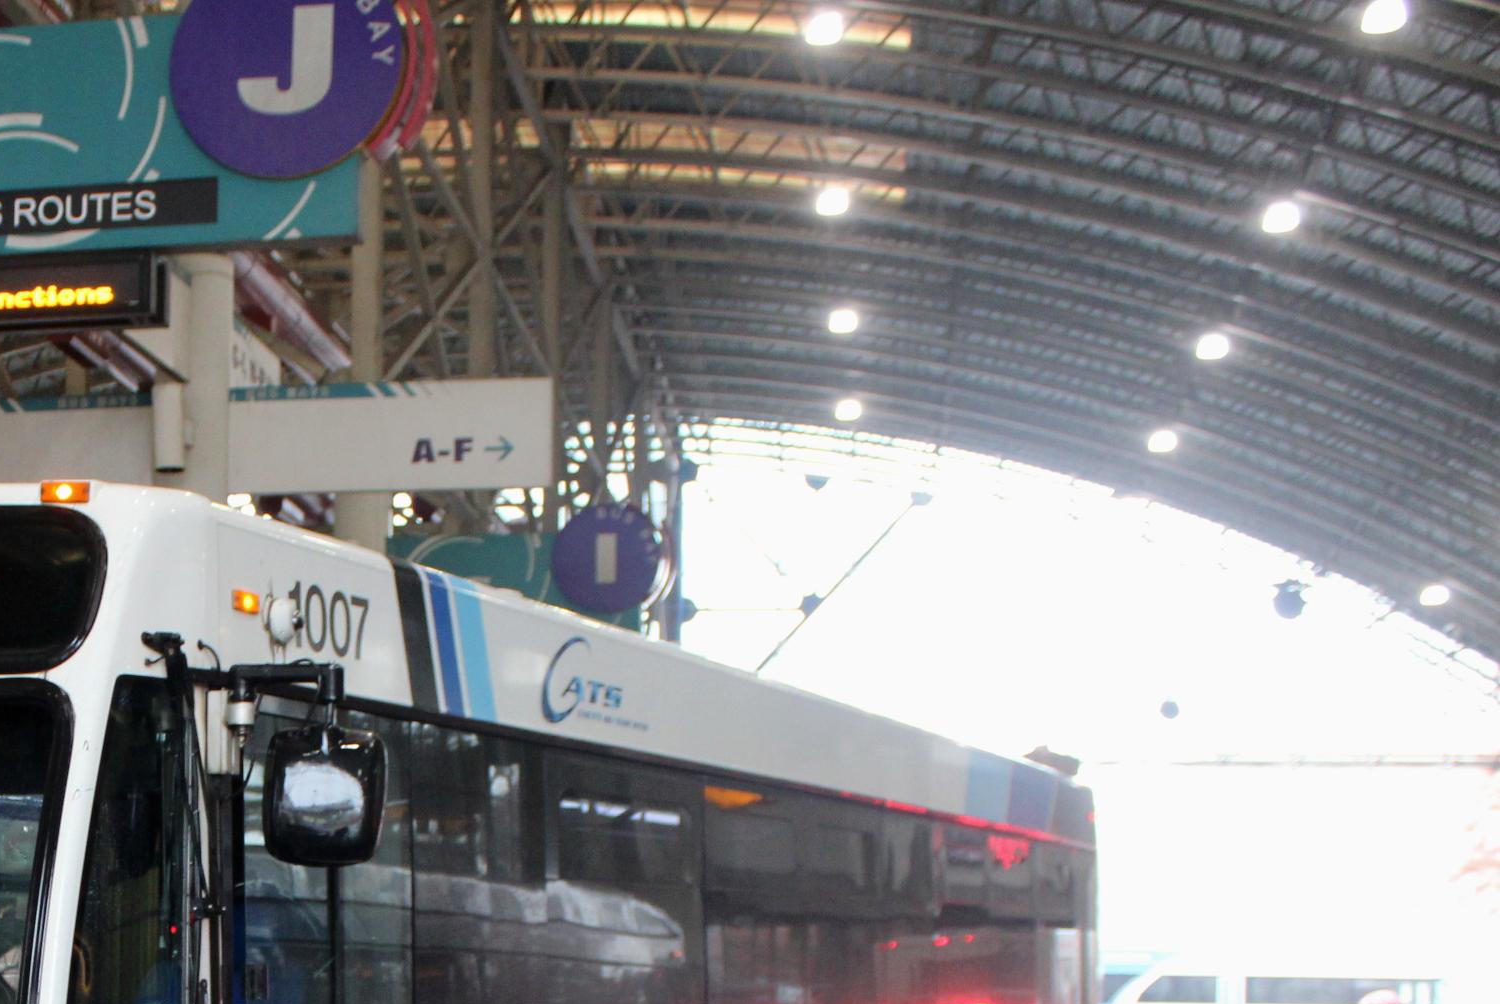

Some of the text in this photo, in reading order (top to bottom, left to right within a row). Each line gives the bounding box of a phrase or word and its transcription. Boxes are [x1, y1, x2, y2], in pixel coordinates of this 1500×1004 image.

[237, 4, 335, 115] J
[13, 190, 157, 226] ROUTES
[411, 438, 474, 463] A-F
[595, 533, 618, 585] I
